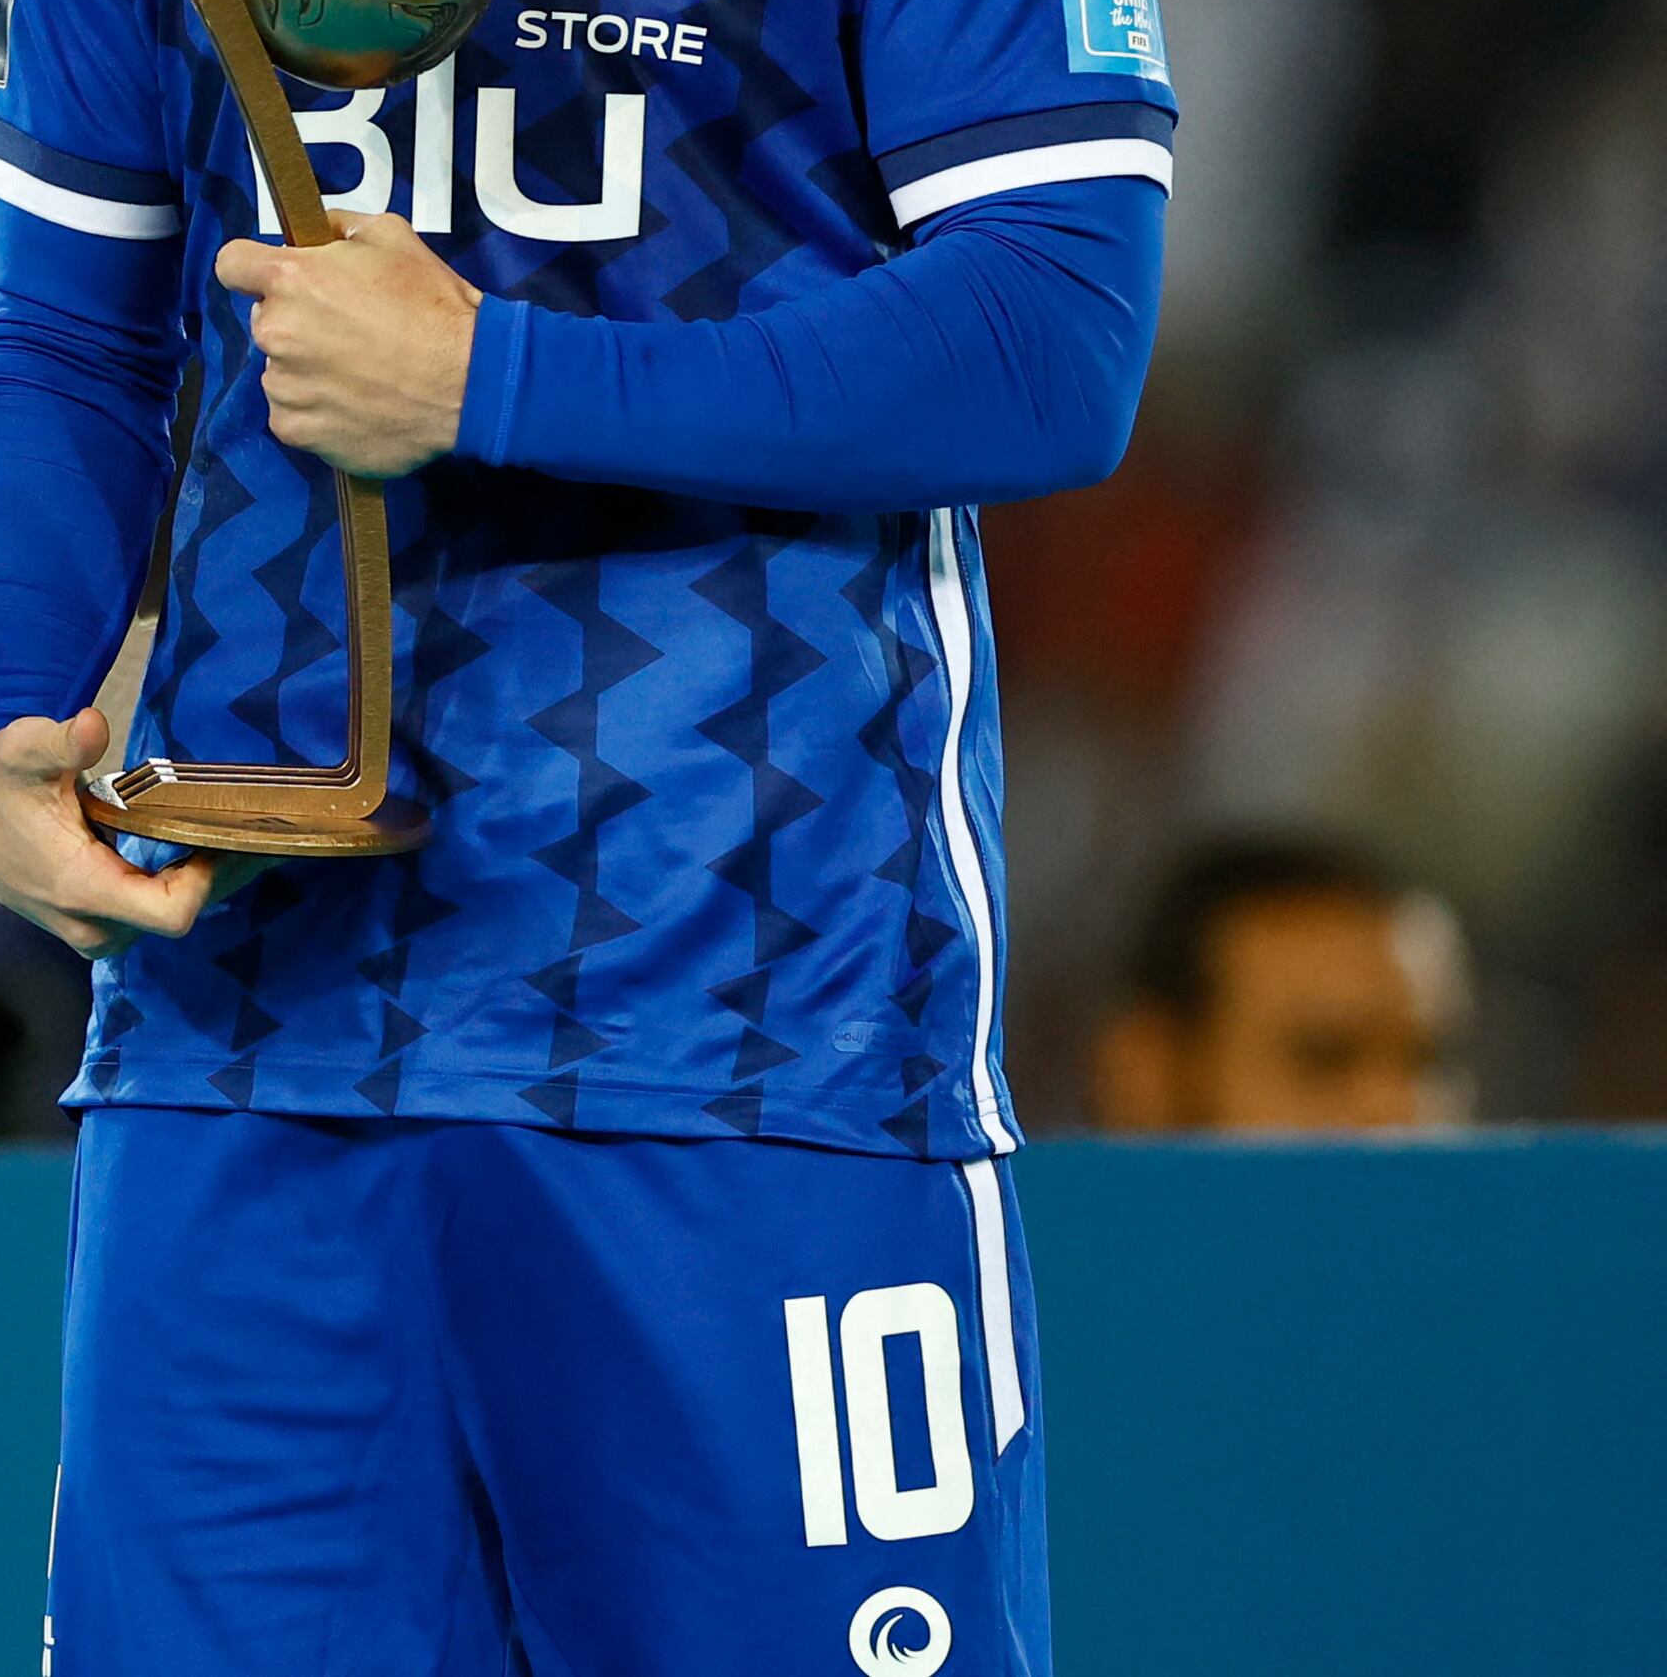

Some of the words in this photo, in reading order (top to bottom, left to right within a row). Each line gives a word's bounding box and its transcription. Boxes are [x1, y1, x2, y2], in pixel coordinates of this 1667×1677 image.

[515, 10, 708, 66] STORE
[1109, 6, 1133, 27] the
[783, 1282, 975, 1548] 10
